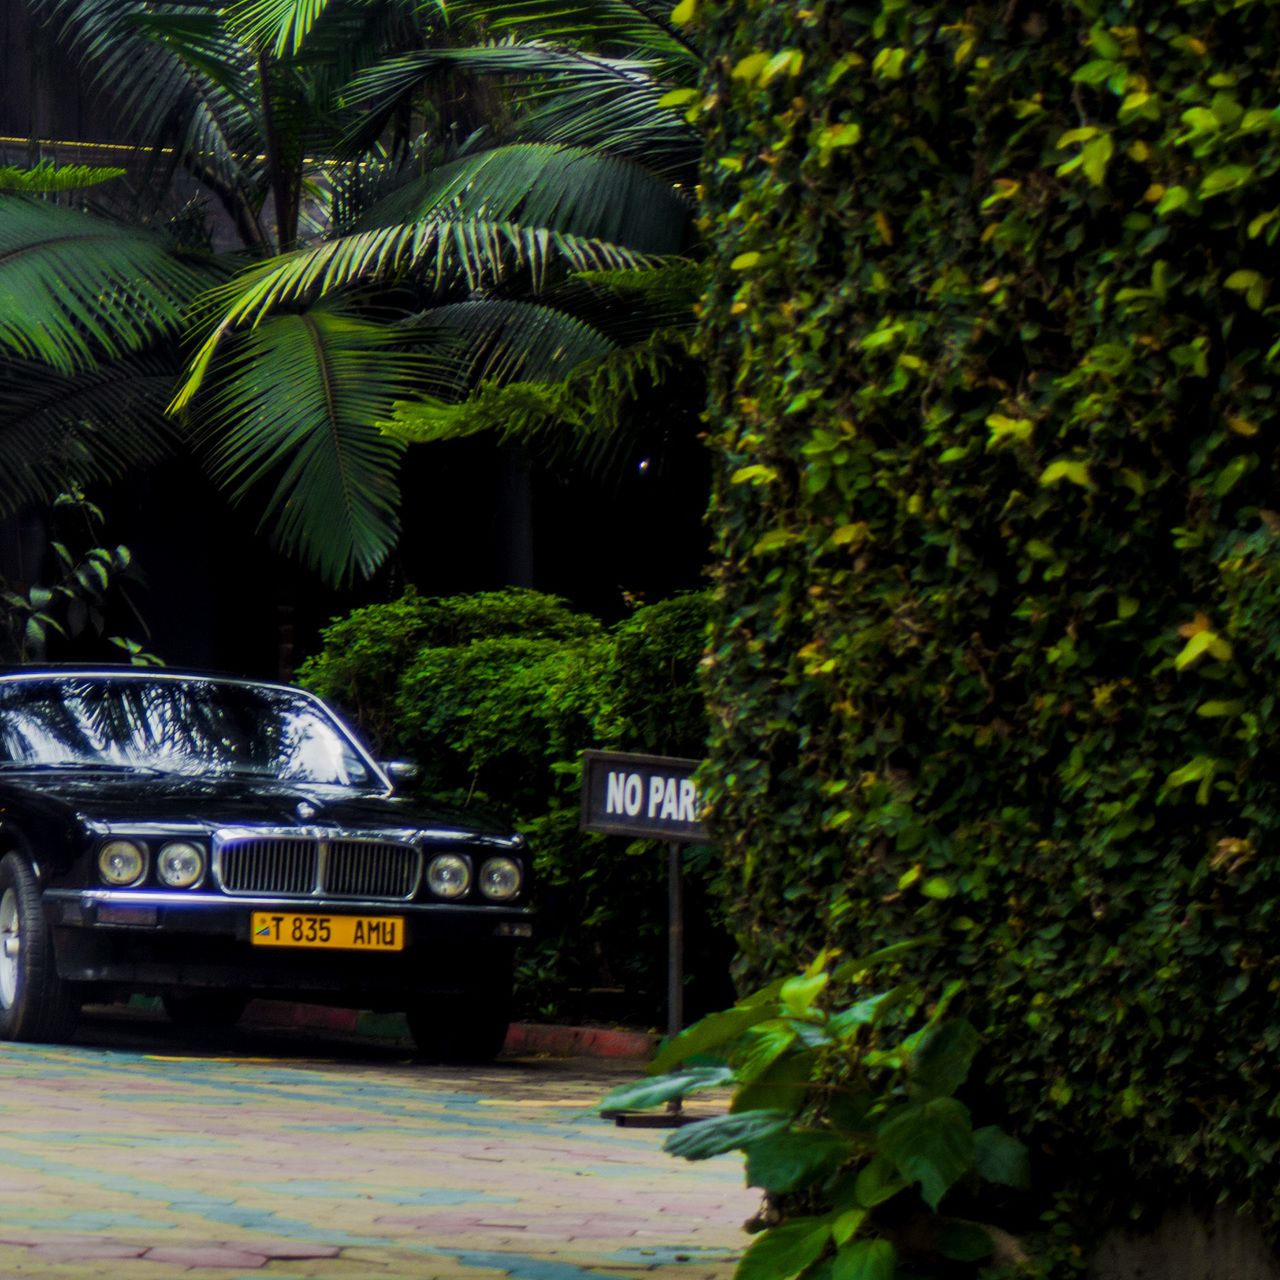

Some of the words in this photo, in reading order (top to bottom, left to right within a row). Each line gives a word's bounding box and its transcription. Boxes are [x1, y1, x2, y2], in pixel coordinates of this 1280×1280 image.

[606, 771, 643, 816] NO
[271, 917, 284, 941] T
[292, 917, 331, 942] 835
[353, 921, 395, 946] AMU
